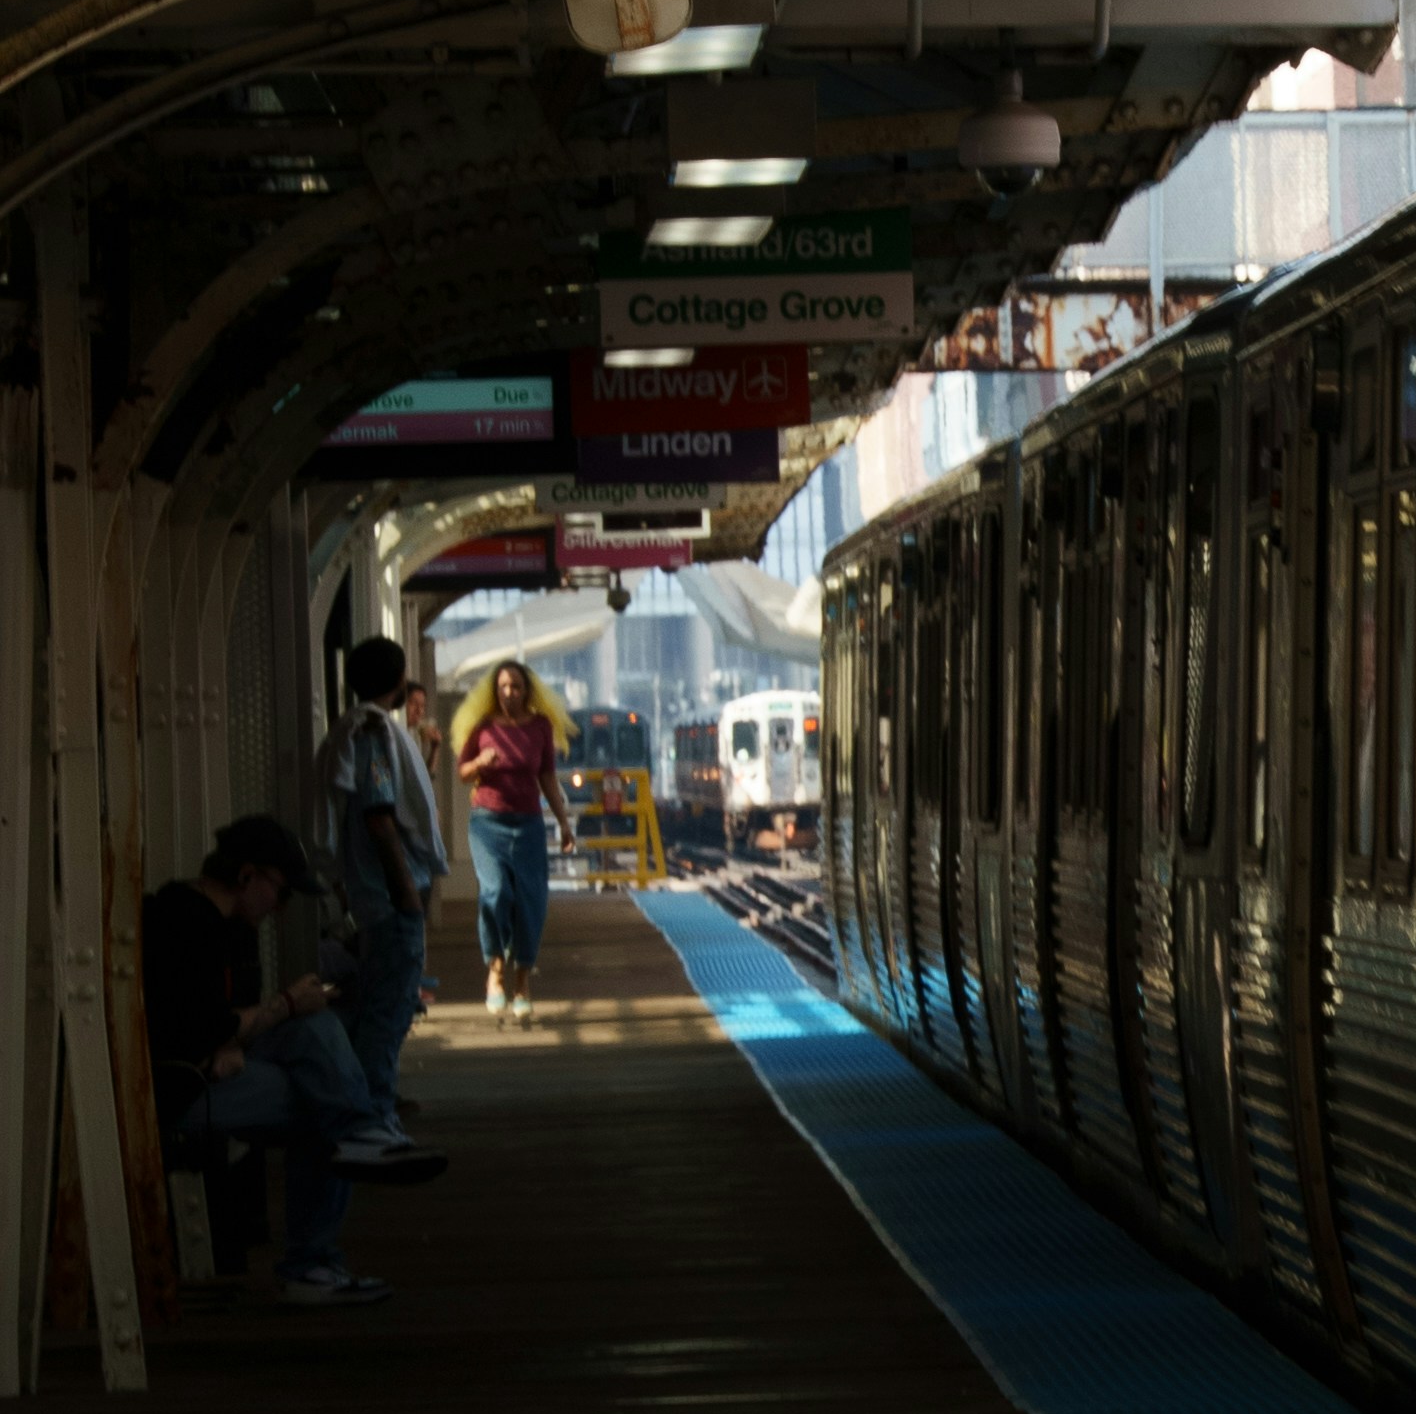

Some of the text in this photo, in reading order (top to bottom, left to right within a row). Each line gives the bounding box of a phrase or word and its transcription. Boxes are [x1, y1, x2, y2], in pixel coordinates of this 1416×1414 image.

[628, 290, 886, 329] Cottage Grove
[494, 386, 529, 404] Due
[592, 367, 739, 407] Midway
[474, 417, 495, 435] 17
[500, 418, 531, 435] min
[621, 430, 733, 458] Linden
[551, 480, 638, 506] Cottage
